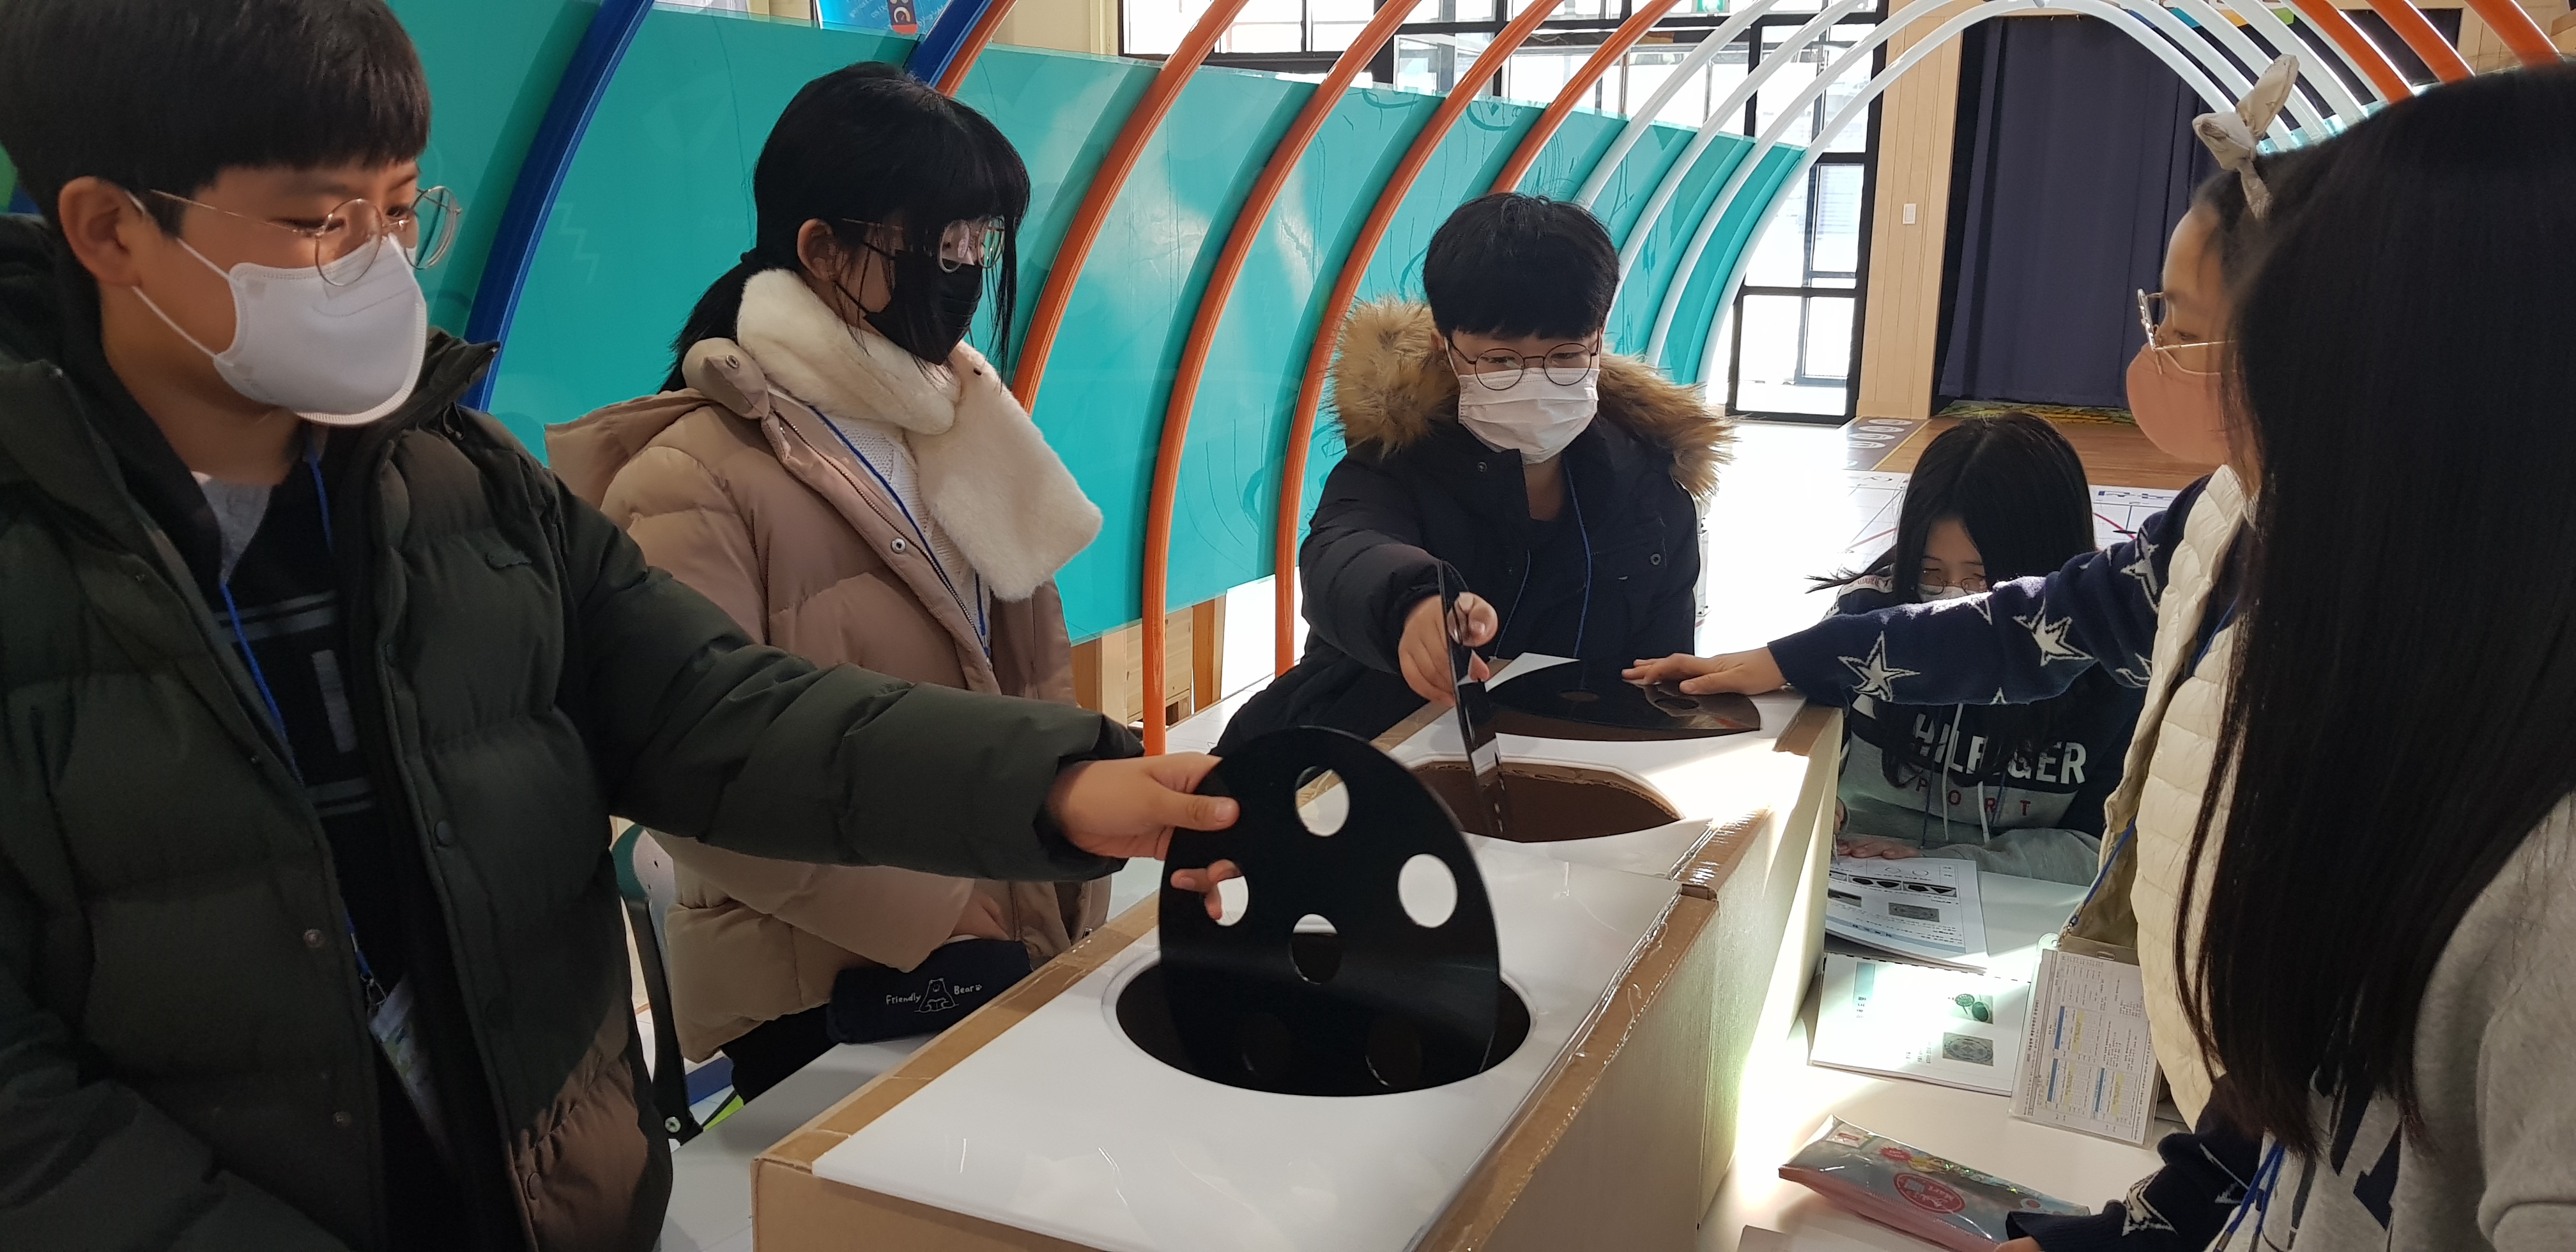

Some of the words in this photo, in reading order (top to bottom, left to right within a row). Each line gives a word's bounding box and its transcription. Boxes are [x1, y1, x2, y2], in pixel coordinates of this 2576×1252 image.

[1913, 713, 2086, 784] HILFGER
[1915, 777, 2032, 816] PORT
[885, 991, 922, 1005] Friendly
[953, 985, 974, 995] Bear
